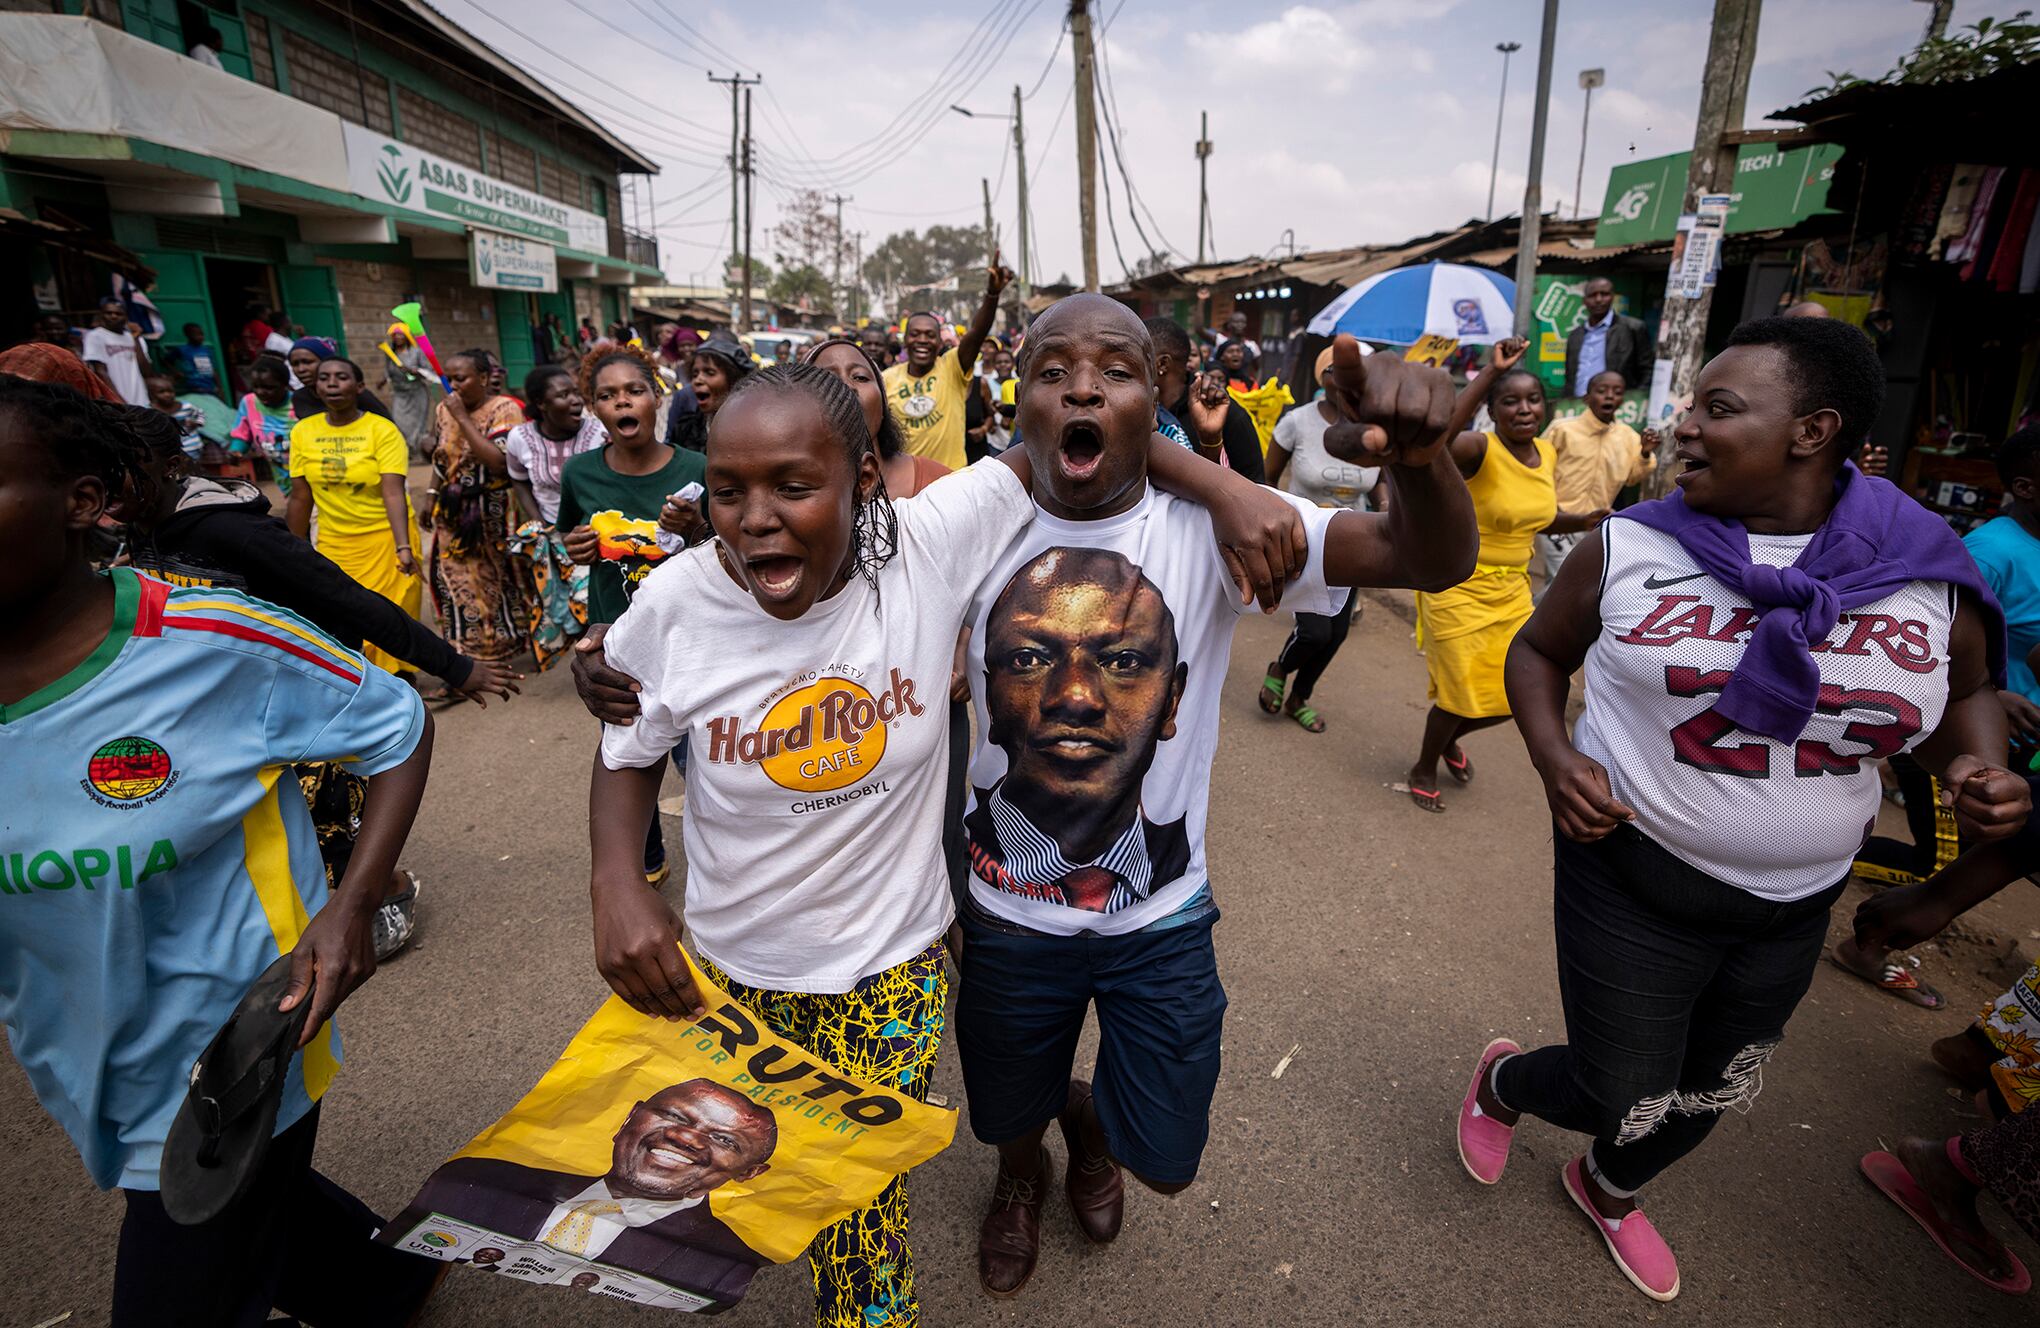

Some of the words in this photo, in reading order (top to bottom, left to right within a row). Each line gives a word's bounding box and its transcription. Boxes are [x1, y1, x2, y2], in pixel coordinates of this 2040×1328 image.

[1738, 154, 1775, 173] TECH
[419, 158, 468, 194] ASAS
[472, 178, 569, 227] SUPERMARKET
[1613, 189, 1649, 221] 4G
[494, 236, 525, 256] ASAS
[494, 254, 553, 274] SUPERMARKET
[320, 447, 360, 455] COMING
[1321, 465, 1363, 483] GET
[706, 705, 814, 764] Hard
[818, 667, 925, 745] Rock
[1664, 664, 1925, 779] 23
[799, 747, 862, 779] CAFE
[104, 799, 144, 811] football
[790, 780, 891, 815] CHERNOBYL
[696, 1003, 903, 1126] RUTO
[680, 1026, 728, 1065] FOR
[731, 1072, 870, 1140] PRESIDENT
[409, 1241, 443, 1257] UDA
[505, 1268, 530, 1276] RUTO
[519, 1256, 556, 1274] WILLIAM
[603, 1284, 637, 1300] RIGATHI
